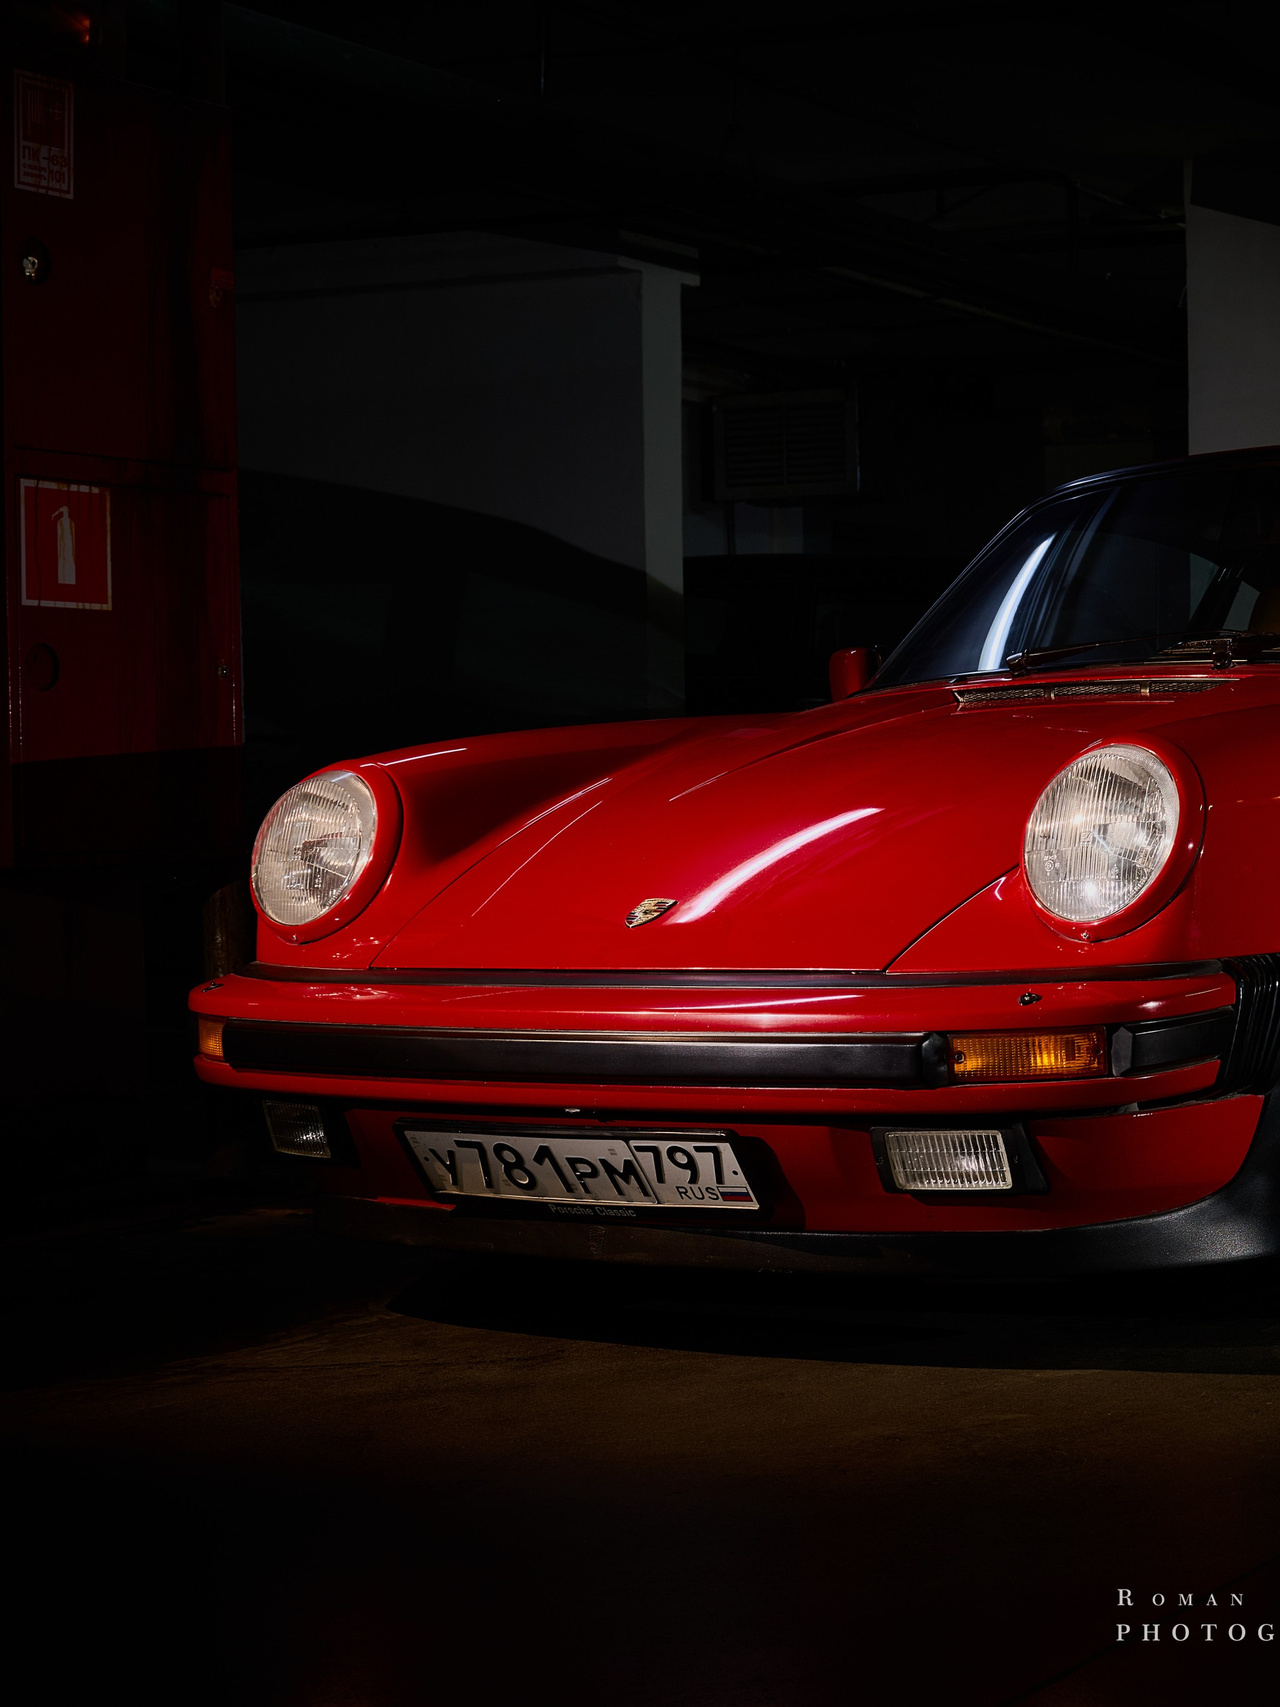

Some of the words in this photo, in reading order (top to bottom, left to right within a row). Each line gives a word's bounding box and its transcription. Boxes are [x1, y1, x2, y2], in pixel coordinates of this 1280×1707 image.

[633, 1145, 725, 1185] 797
[676, 1185, 719, 1200] RUS
[548, 1203, 594, 1216] Porsche
[595, 1206, 637, 1217] Classic
